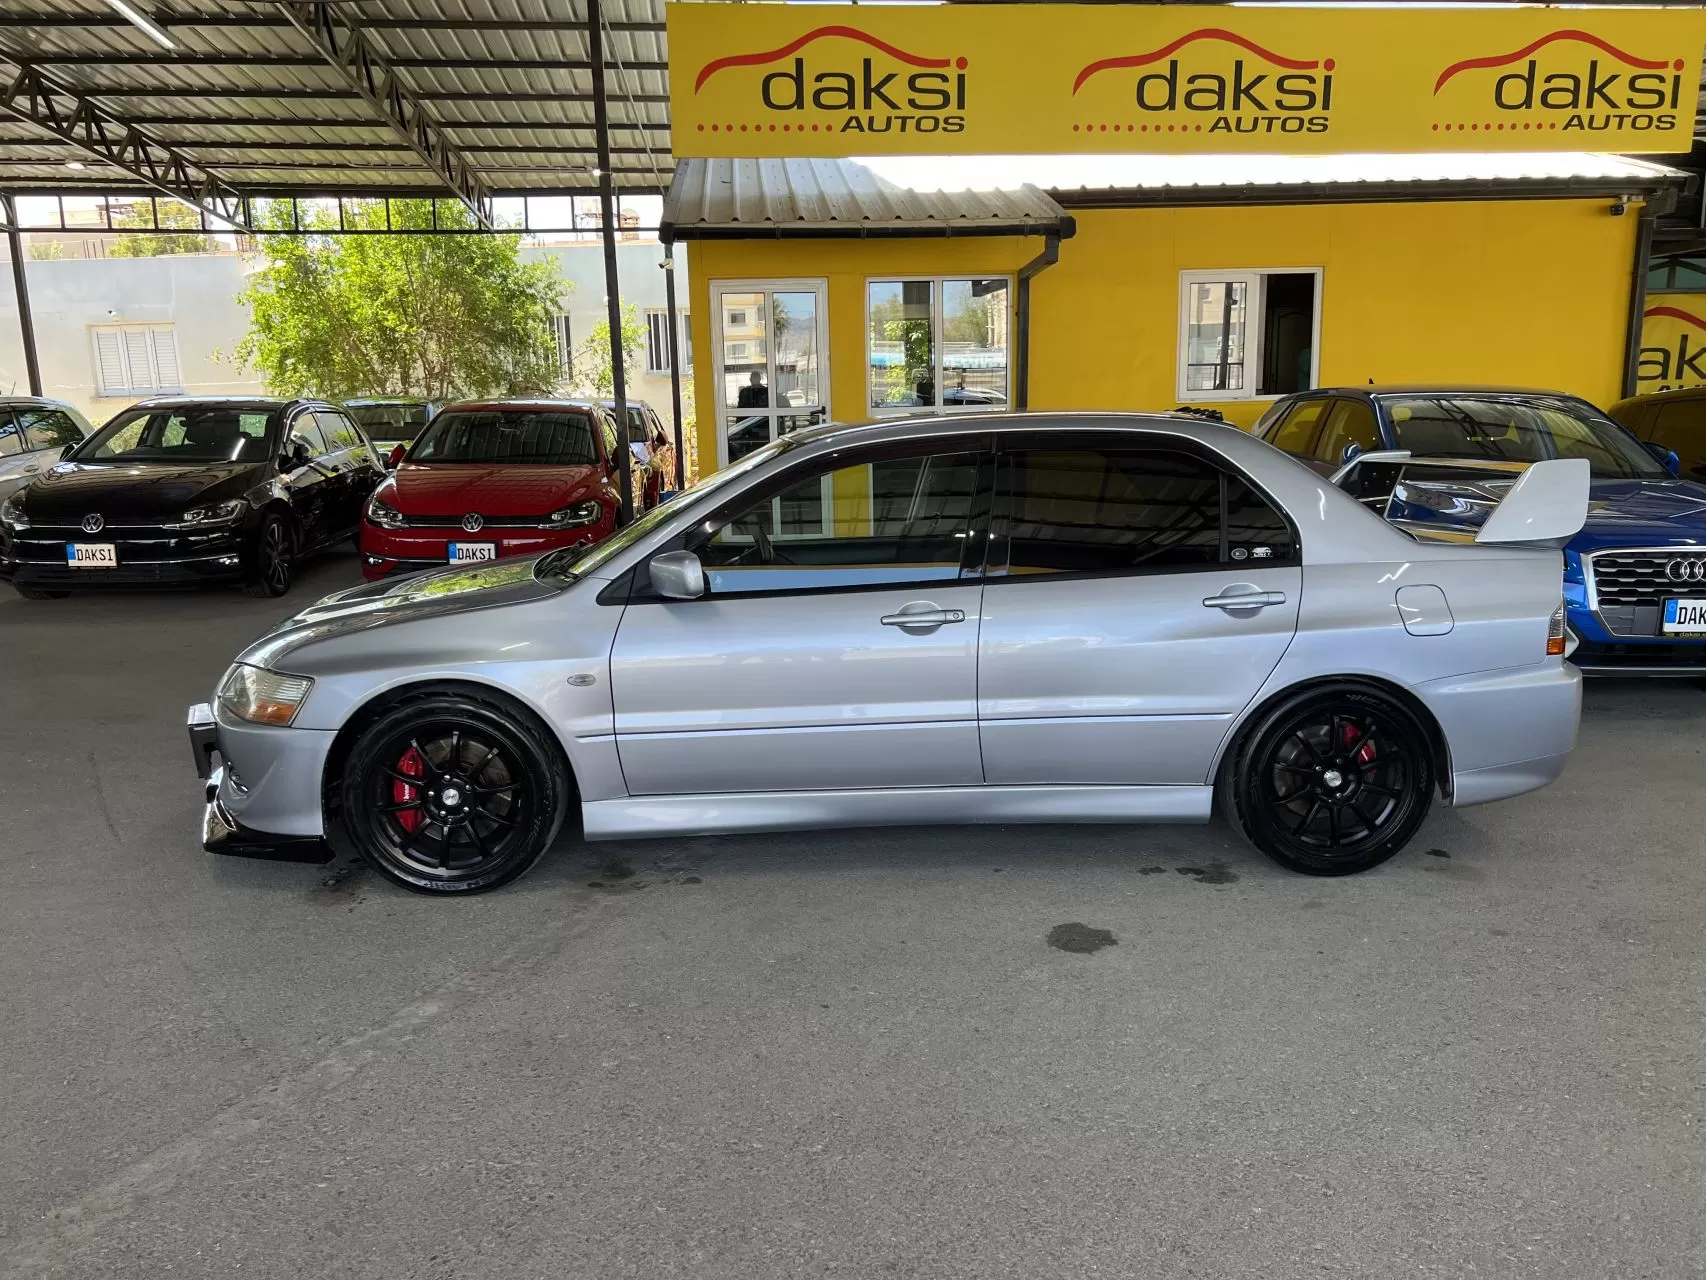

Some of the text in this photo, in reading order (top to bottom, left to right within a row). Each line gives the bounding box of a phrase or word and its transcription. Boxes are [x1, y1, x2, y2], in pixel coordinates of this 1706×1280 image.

[762, 57, 968, 110] daksi
[1136, 58, 1335, 111] daksi
[1495, 58, 1684, 110] daksi
[840, 116, 965, 132] AUTOS
[1208, 116, 1329, 133] AUTOS
[1562, 114, 1676, 131] AUTOS
[76, 549, 113, 561] DAKSI
[457, 548, 491, 560] DAKSI
